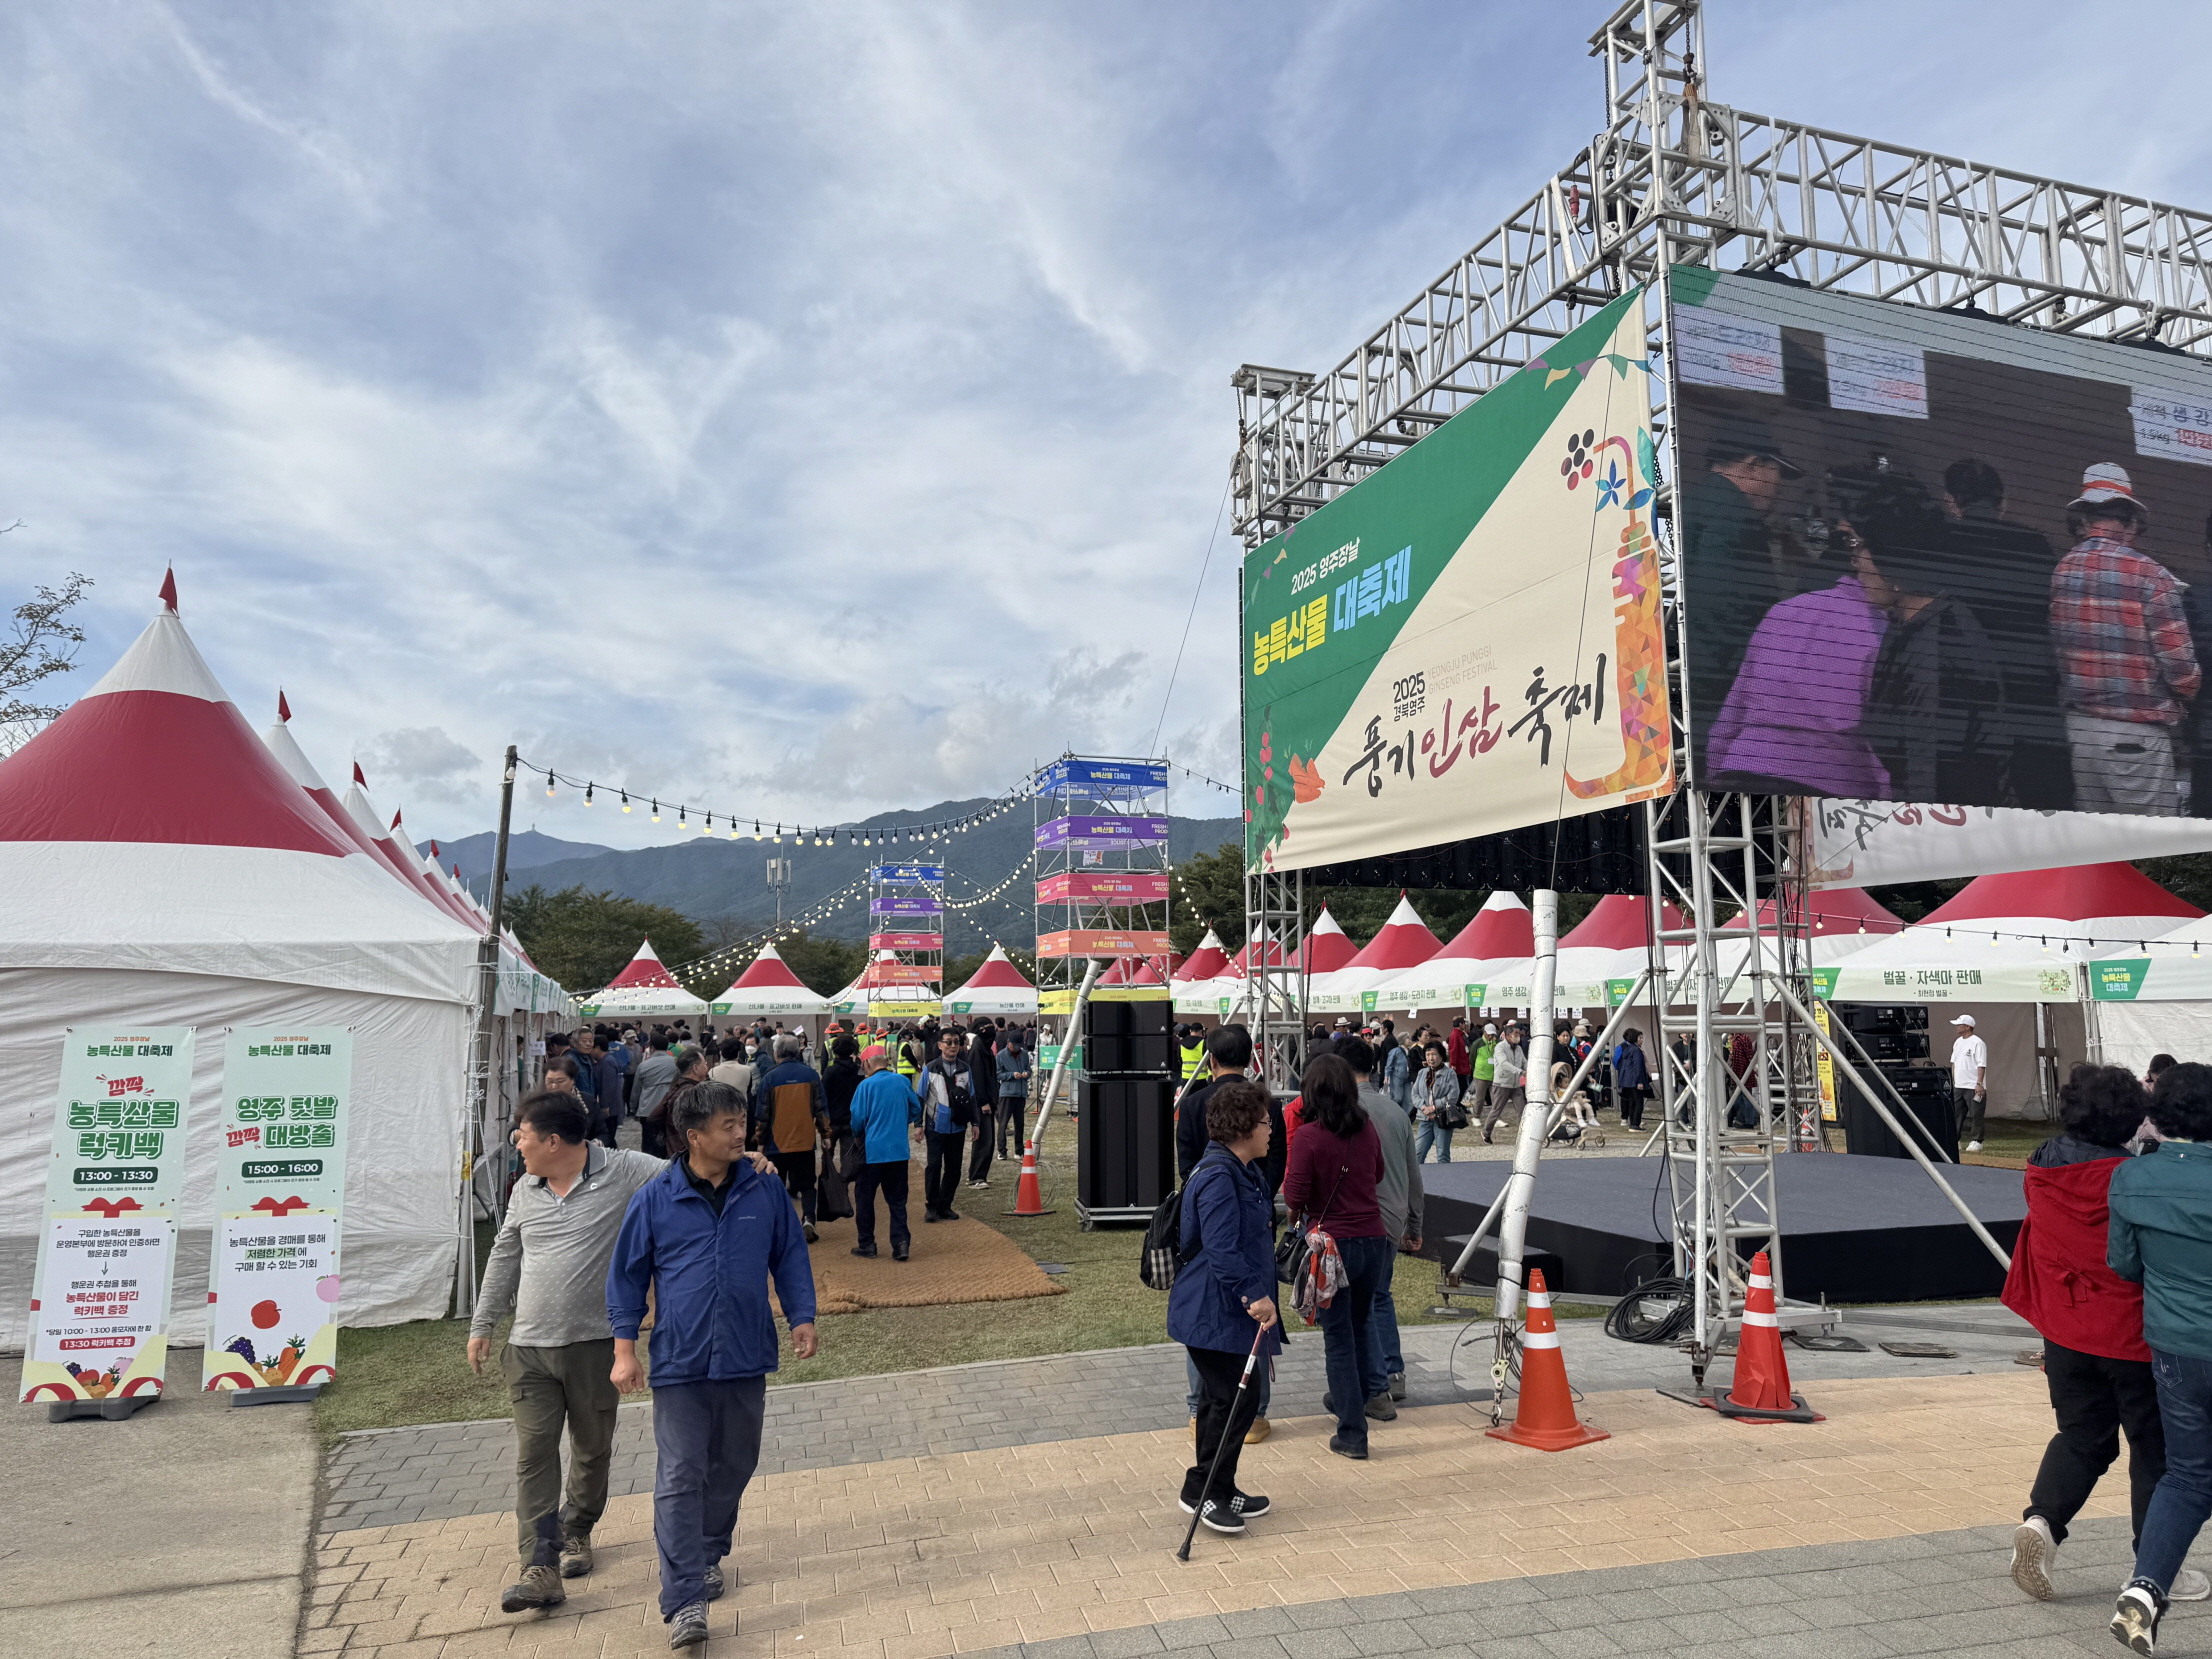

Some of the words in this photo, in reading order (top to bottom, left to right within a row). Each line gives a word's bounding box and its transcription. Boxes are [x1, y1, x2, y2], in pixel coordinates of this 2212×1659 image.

[1291, 563, 1317, 595] 2025
[1319, 537, 1360, 578] 영주장날
[1253, 594, 1328, 676] 농특산물
[1333, 544, 1412, 632] 대축제
[1427, 657, 1460, 680] YEONGJU
[1462, 644, 1492, 667] PUNGGI
[1429, 672, 1461, 694] GINSENG
[1462, 659, 1498, 682] FESTIVAL
[1393, 671, 1425, 703] 2025
[1393, 696, 1425, 722] 경북영주
[1883, 970, 1906, 985] 벌꿀
[1917, 970, 1952, 985] 자색마
[1956, 969, 1982, 985] 판매
[2102, 973, 2130, 982] 농특산물
[1502, 987, 1514, 997] 영주
[1515, 986, 1527, 996] 생강
[87, 1045, 134, 1056] 농특산물
[137, 1045, 173, 1056] 대축제
[248, 1045, 294, 1056] 농특산물
[297, 1044, 331, 1056] 대축제
[108, 1076, 144, 1097] 깜짝
[236, 1096, 285, 1121] 영주
[289, 1095, 338, 1121] 텃밭
[67, 1100, 179, 1129] 농특산물
[226, 1126, 260, 1148] 깜짝
[264, 1123, 335, 1148] 대방출
[77, 1131, 164, 1160] 럭키백
[248, 1165, 279, 1174] 15:00
[288, 1164, 318, 1173] 16:00
[80, 1172, 112, 1181] 13:00
[122, 1171, 153, 1180] 13:30
[78, 1229, 101, 1238] 구입한
[103, 1228, 141, 1237] 농특산물을
[56, 1240, 95, 1249] 운영본부에
[97, 1239, 128, 1247] 방문하여
[129, 1238, 160, 1247] 인증하면
[230, 1236, 276, 1247] 농특산물을
[278, 1235, 305, 1245] 경매를
[308, 1234, 326, 1243] 통해
[87, 1250, 110, 1258] 행운권
[112, 1249, 127, 1257] 증정
[247, 1249, 276, 1259] 저렴한
[277, 1248, 296, 1257] 가격
[235, 1262, 253, 1272] 구매
[256, 1261, 265, 1271] 할
[267, 1261, 276, 1270] 수
[279, 1260, 297, 1270] 있는
[299, 1259, 317, 1268] 기회
[71, 1281, 94, 1289] 행운권
[96, 1280, 119, 1288] 추첨을
[66, 1292, 116, 1303] 농특산물이
[118, 1291, 139, 1300] 담긴
[74, 1305, 104, 1316] 럭키백
[108, 1305, 128, 1315] 증정
[115, 1338, 131, 1346] 추첨
